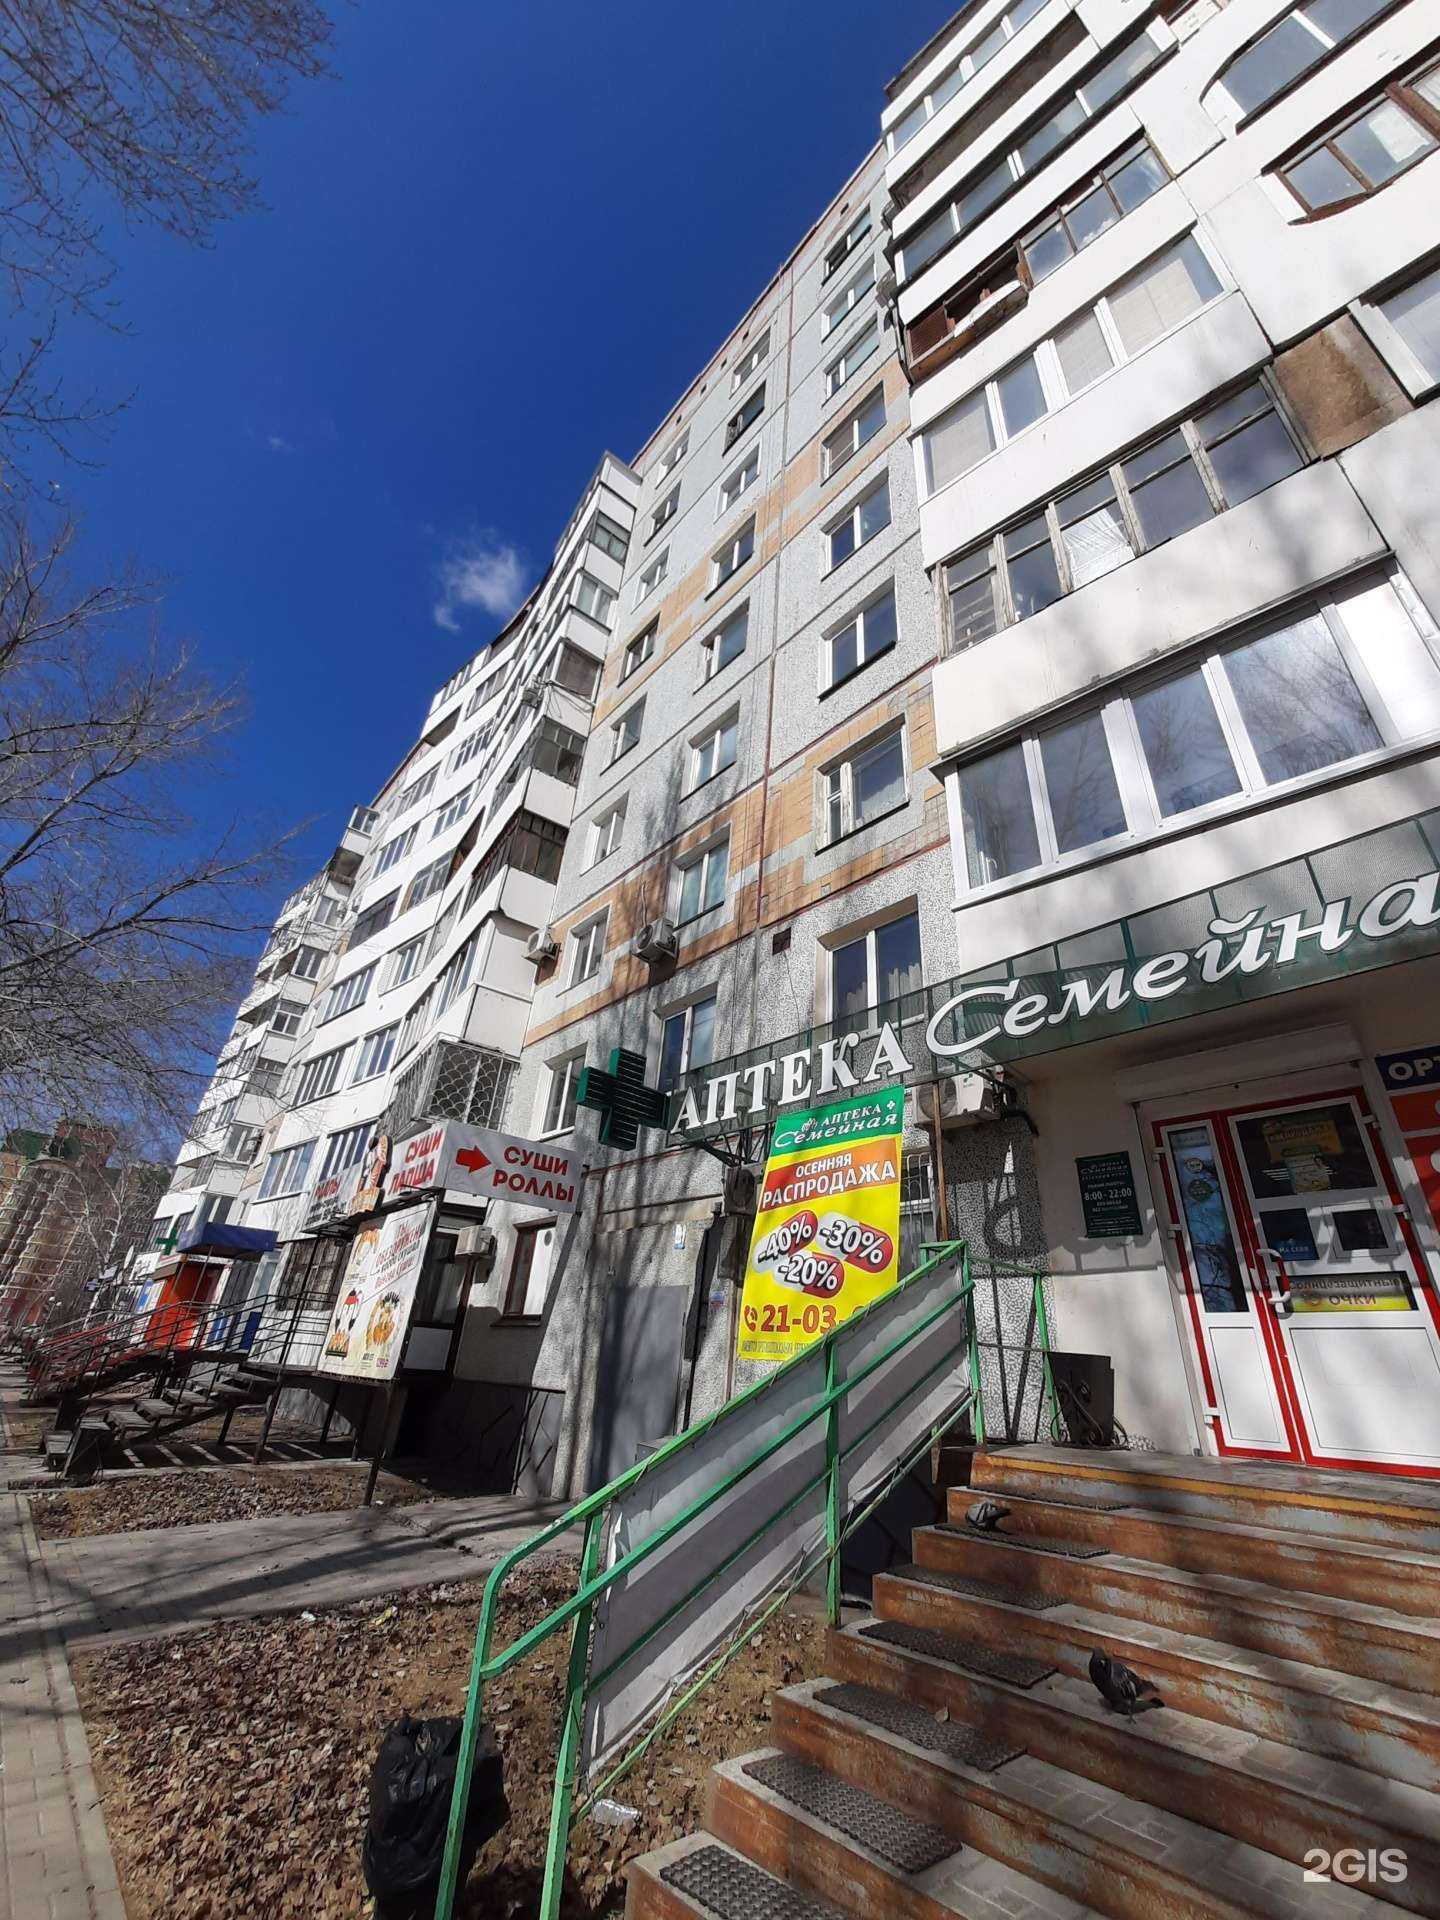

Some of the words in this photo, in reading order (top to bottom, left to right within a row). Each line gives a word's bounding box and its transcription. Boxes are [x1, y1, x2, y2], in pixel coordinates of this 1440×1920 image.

[671, 1021, 913, 1135] АПТЕКА
[775, 1112, 897, 1148] Семейная
[821, 1103, 882, 1126] АПТЕКА
[404, 1128, 444, 1164] СУШИ
[503, 1145, 569, 1176] СУШИ
[388, 1158, 436, 1196] ЛАПША
[795, 1152, 853, 1179] ОСЕННЯЯ
[492, 1168, 575, 1203] РОЛЛЫ
[761, 1160, 896, 1209] РАСПРОДАЖА
[1109, 1187, 1132, 1199] 22:00
[758, 1213, 813, 1263] -40%
[820, 1219, 885, 1265] -30%
[778, 1254, 839, 1291] -20%
[760, 1303, 865, 1334] 21-03-
